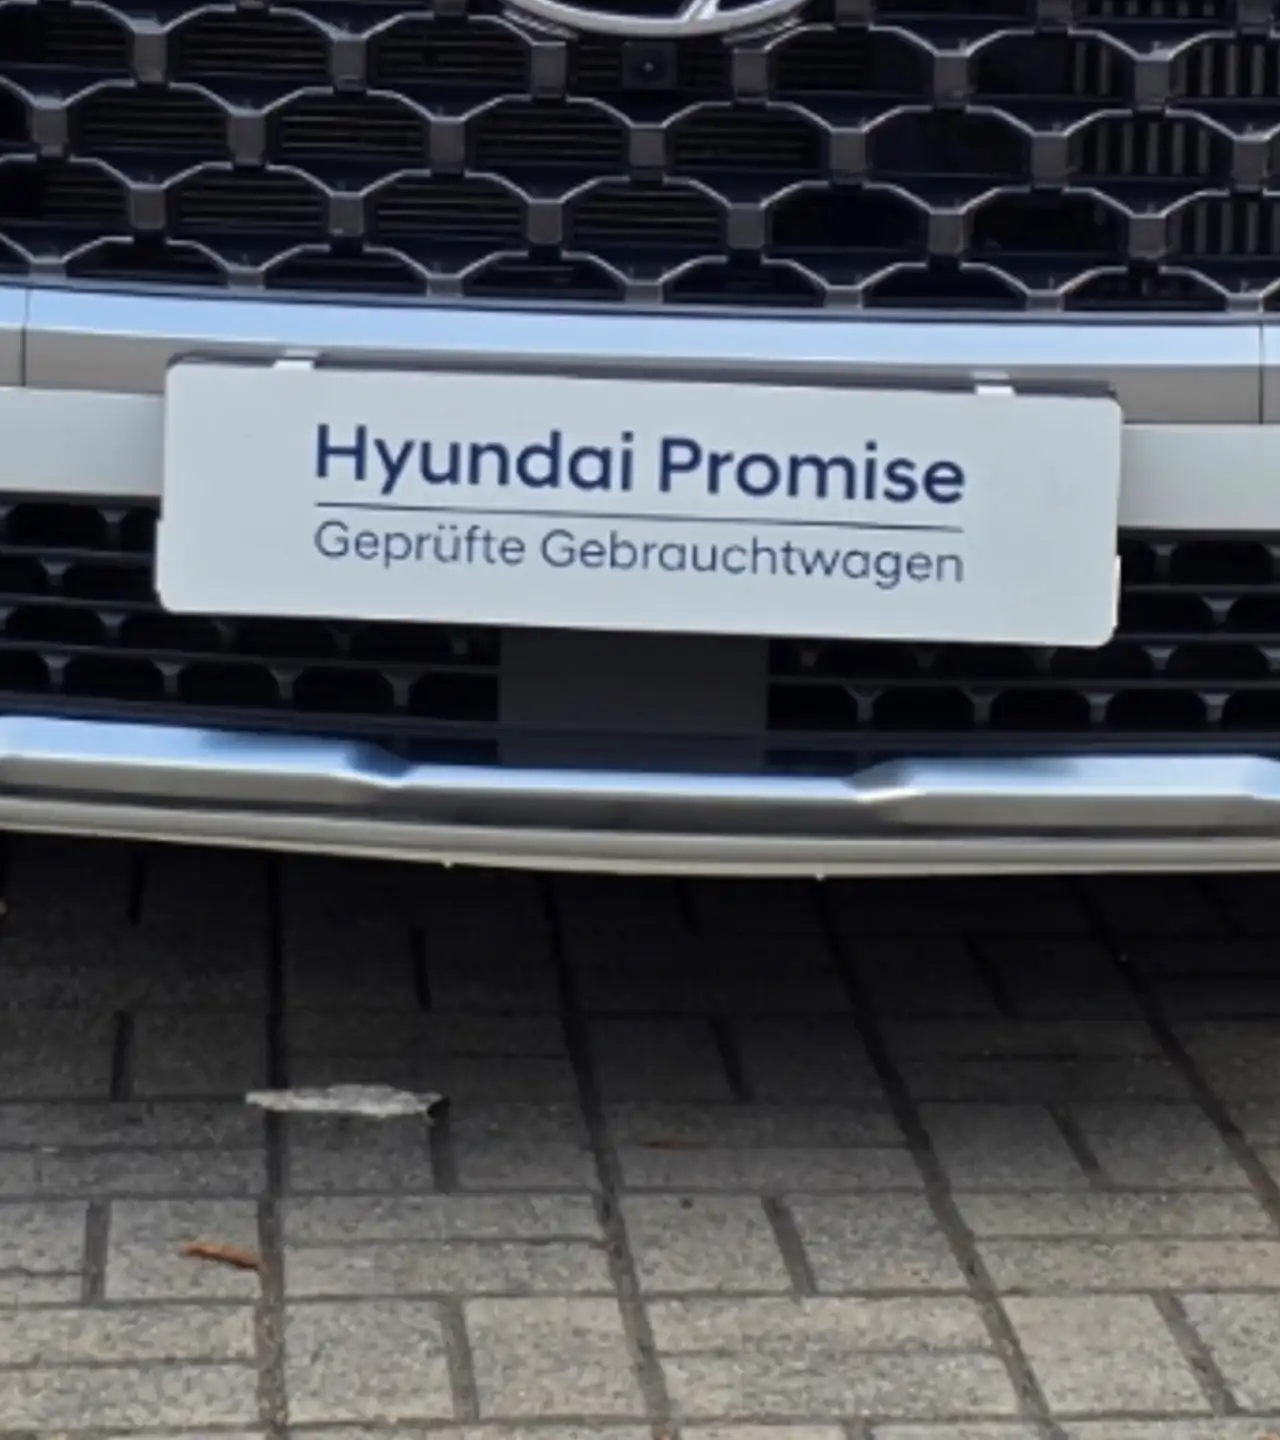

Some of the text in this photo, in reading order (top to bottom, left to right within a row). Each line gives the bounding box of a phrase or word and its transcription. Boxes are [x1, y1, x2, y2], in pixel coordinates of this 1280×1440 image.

[315, 422, 966, 504] Hyundai Promise
[314, 519, 964, 590] Geprüfte Gebrauchtwagen
